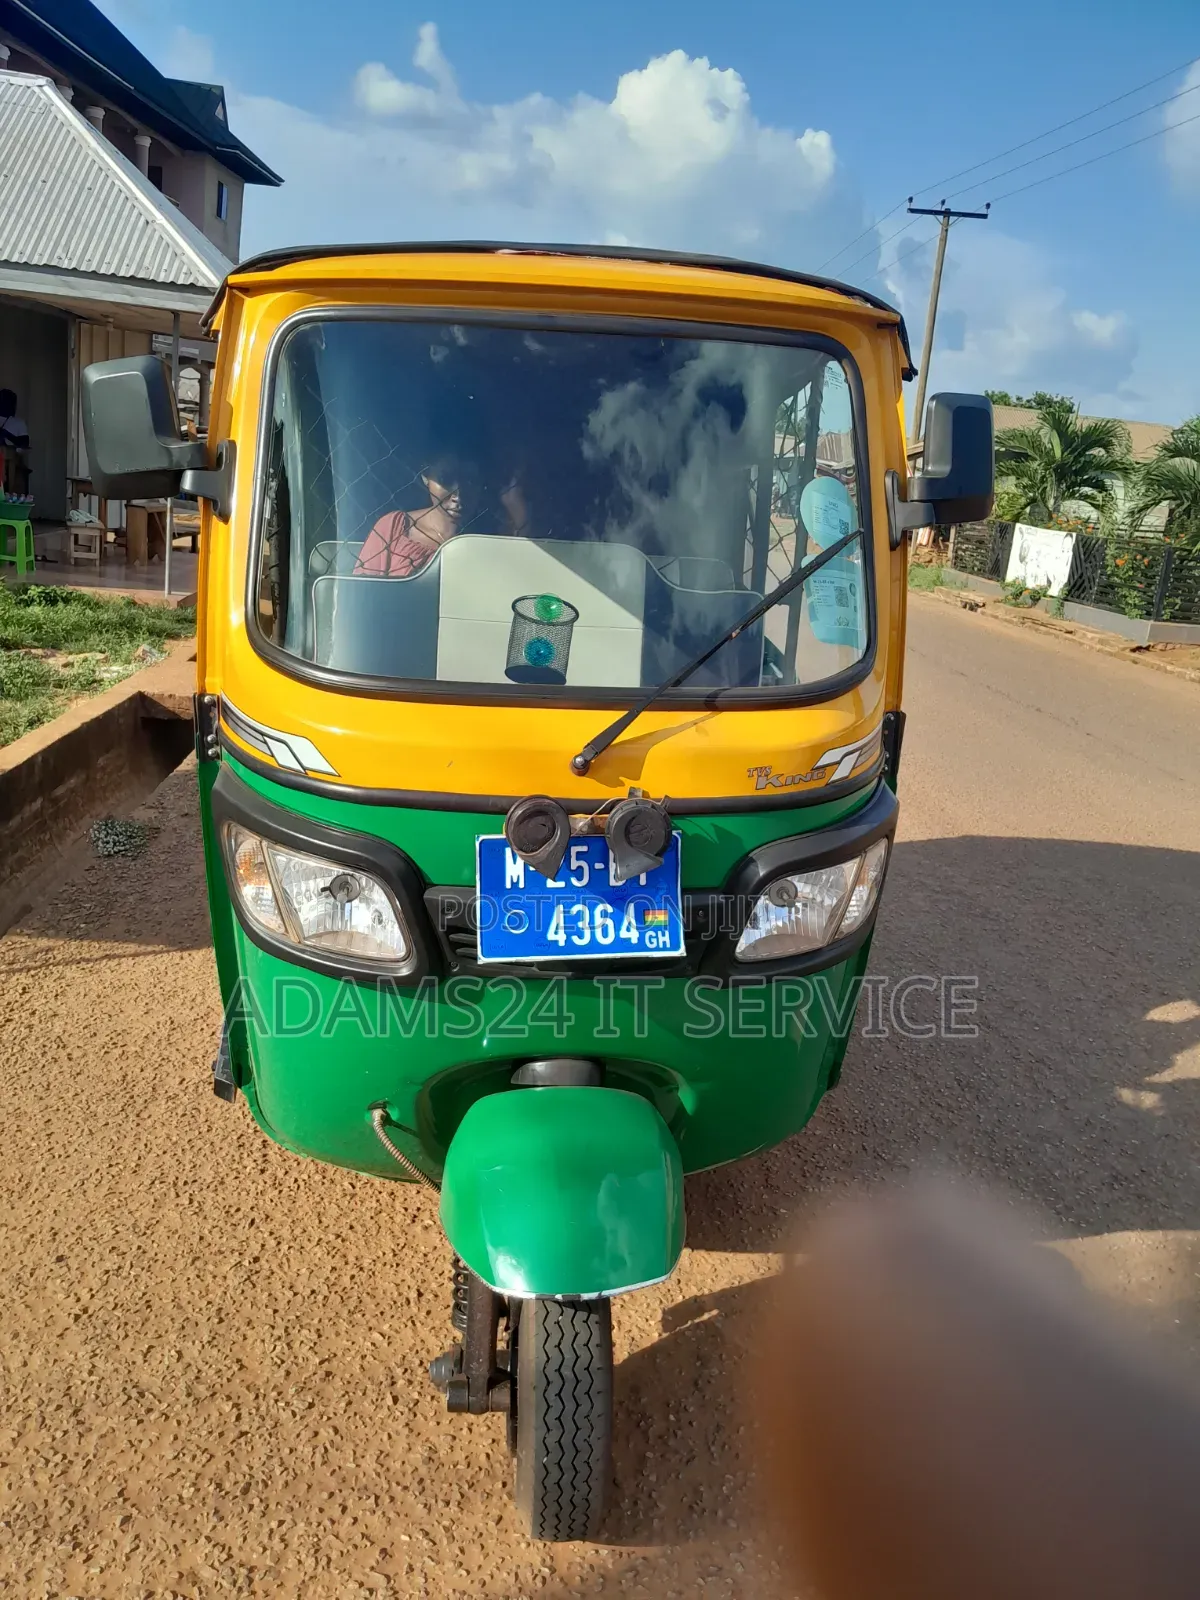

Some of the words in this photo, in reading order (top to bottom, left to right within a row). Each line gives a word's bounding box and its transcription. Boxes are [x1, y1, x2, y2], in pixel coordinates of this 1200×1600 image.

[747, 765, 772, 778] TVS
[755, 768, 826, 790] KING
[546, 903, 639, 947] 4364
[645, 931, 671, 949] GH
